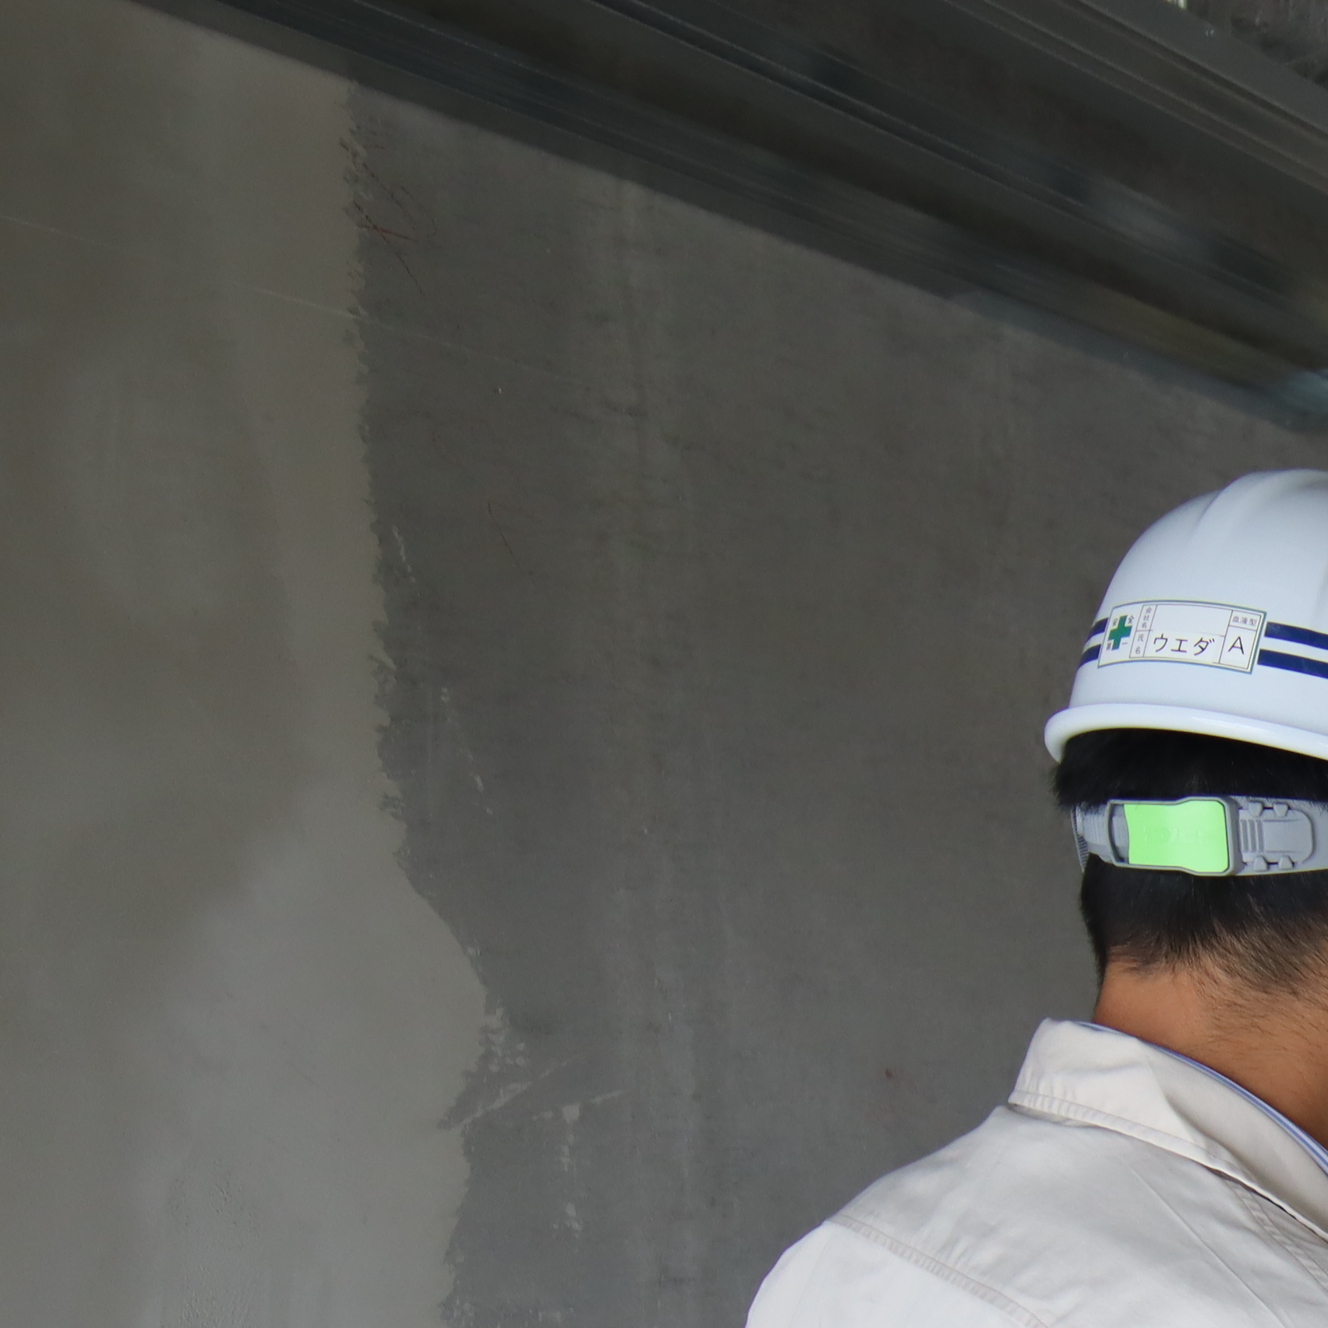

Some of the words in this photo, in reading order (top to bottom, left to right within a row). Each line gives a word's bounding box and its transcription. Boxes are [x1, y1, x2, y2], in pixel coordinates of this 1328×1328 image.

[1153, 633, 1216, 657] ウエダ
[1227, 635, 1245, 655] A
